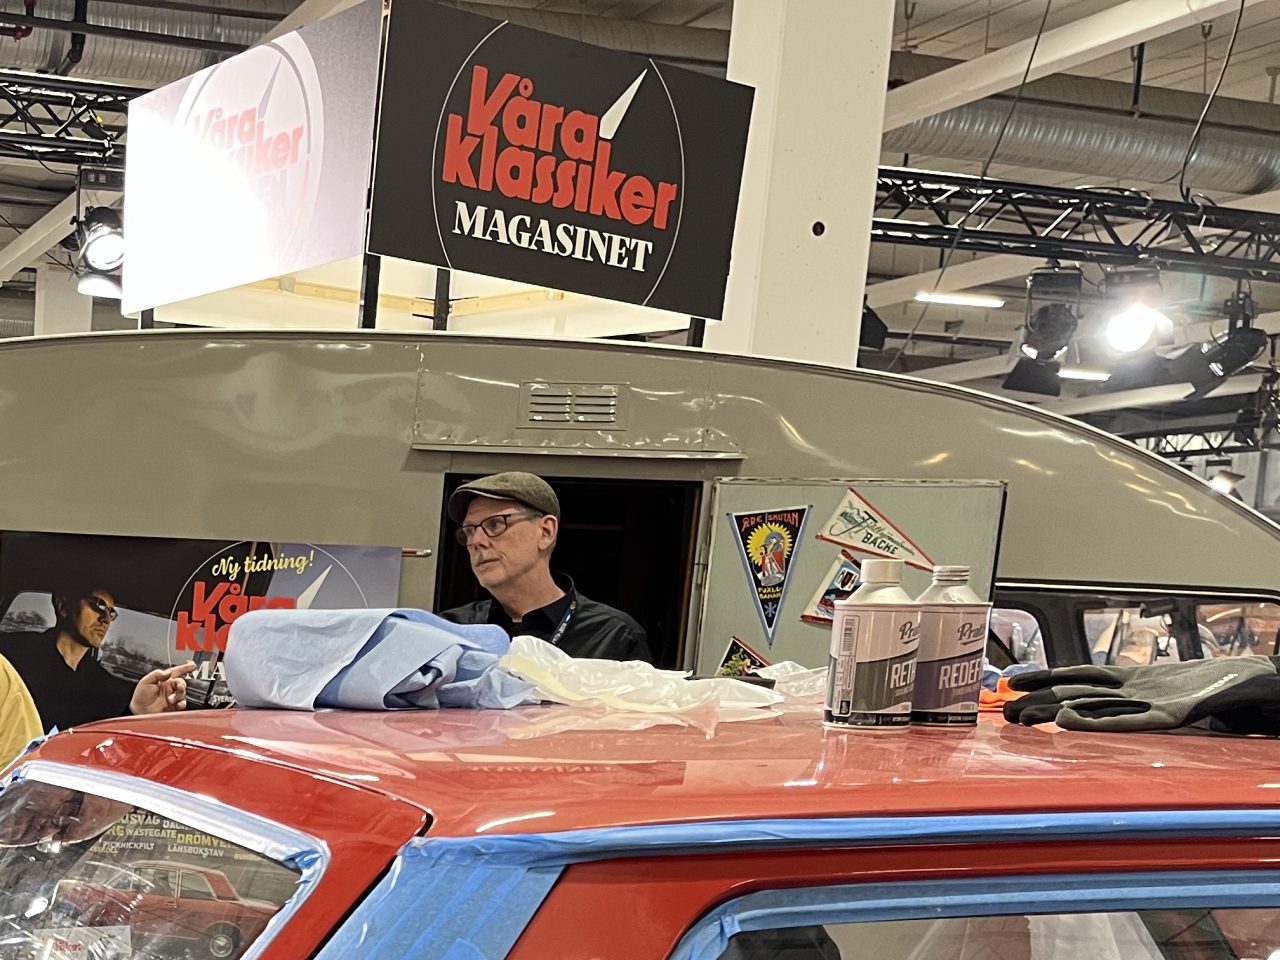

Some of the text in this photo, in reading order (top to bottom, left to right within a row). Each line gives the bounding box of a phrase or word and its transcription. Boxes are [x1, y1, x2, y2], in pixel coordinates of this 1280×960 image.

[467, 65, 598, 161] Våra
[442, 113, 677, 229] klassiker
[452, 200, 653, 271] MAGASINET
[861, 532, 898, 555] BACKE
[212, 550, 314, 581] Ny tidning!
[938, 658, 982, 690] REDEF
[126, 827, 177, 839] WASTEGATE
[167, 843, 224, 858] LÄNSBOKSTAV
